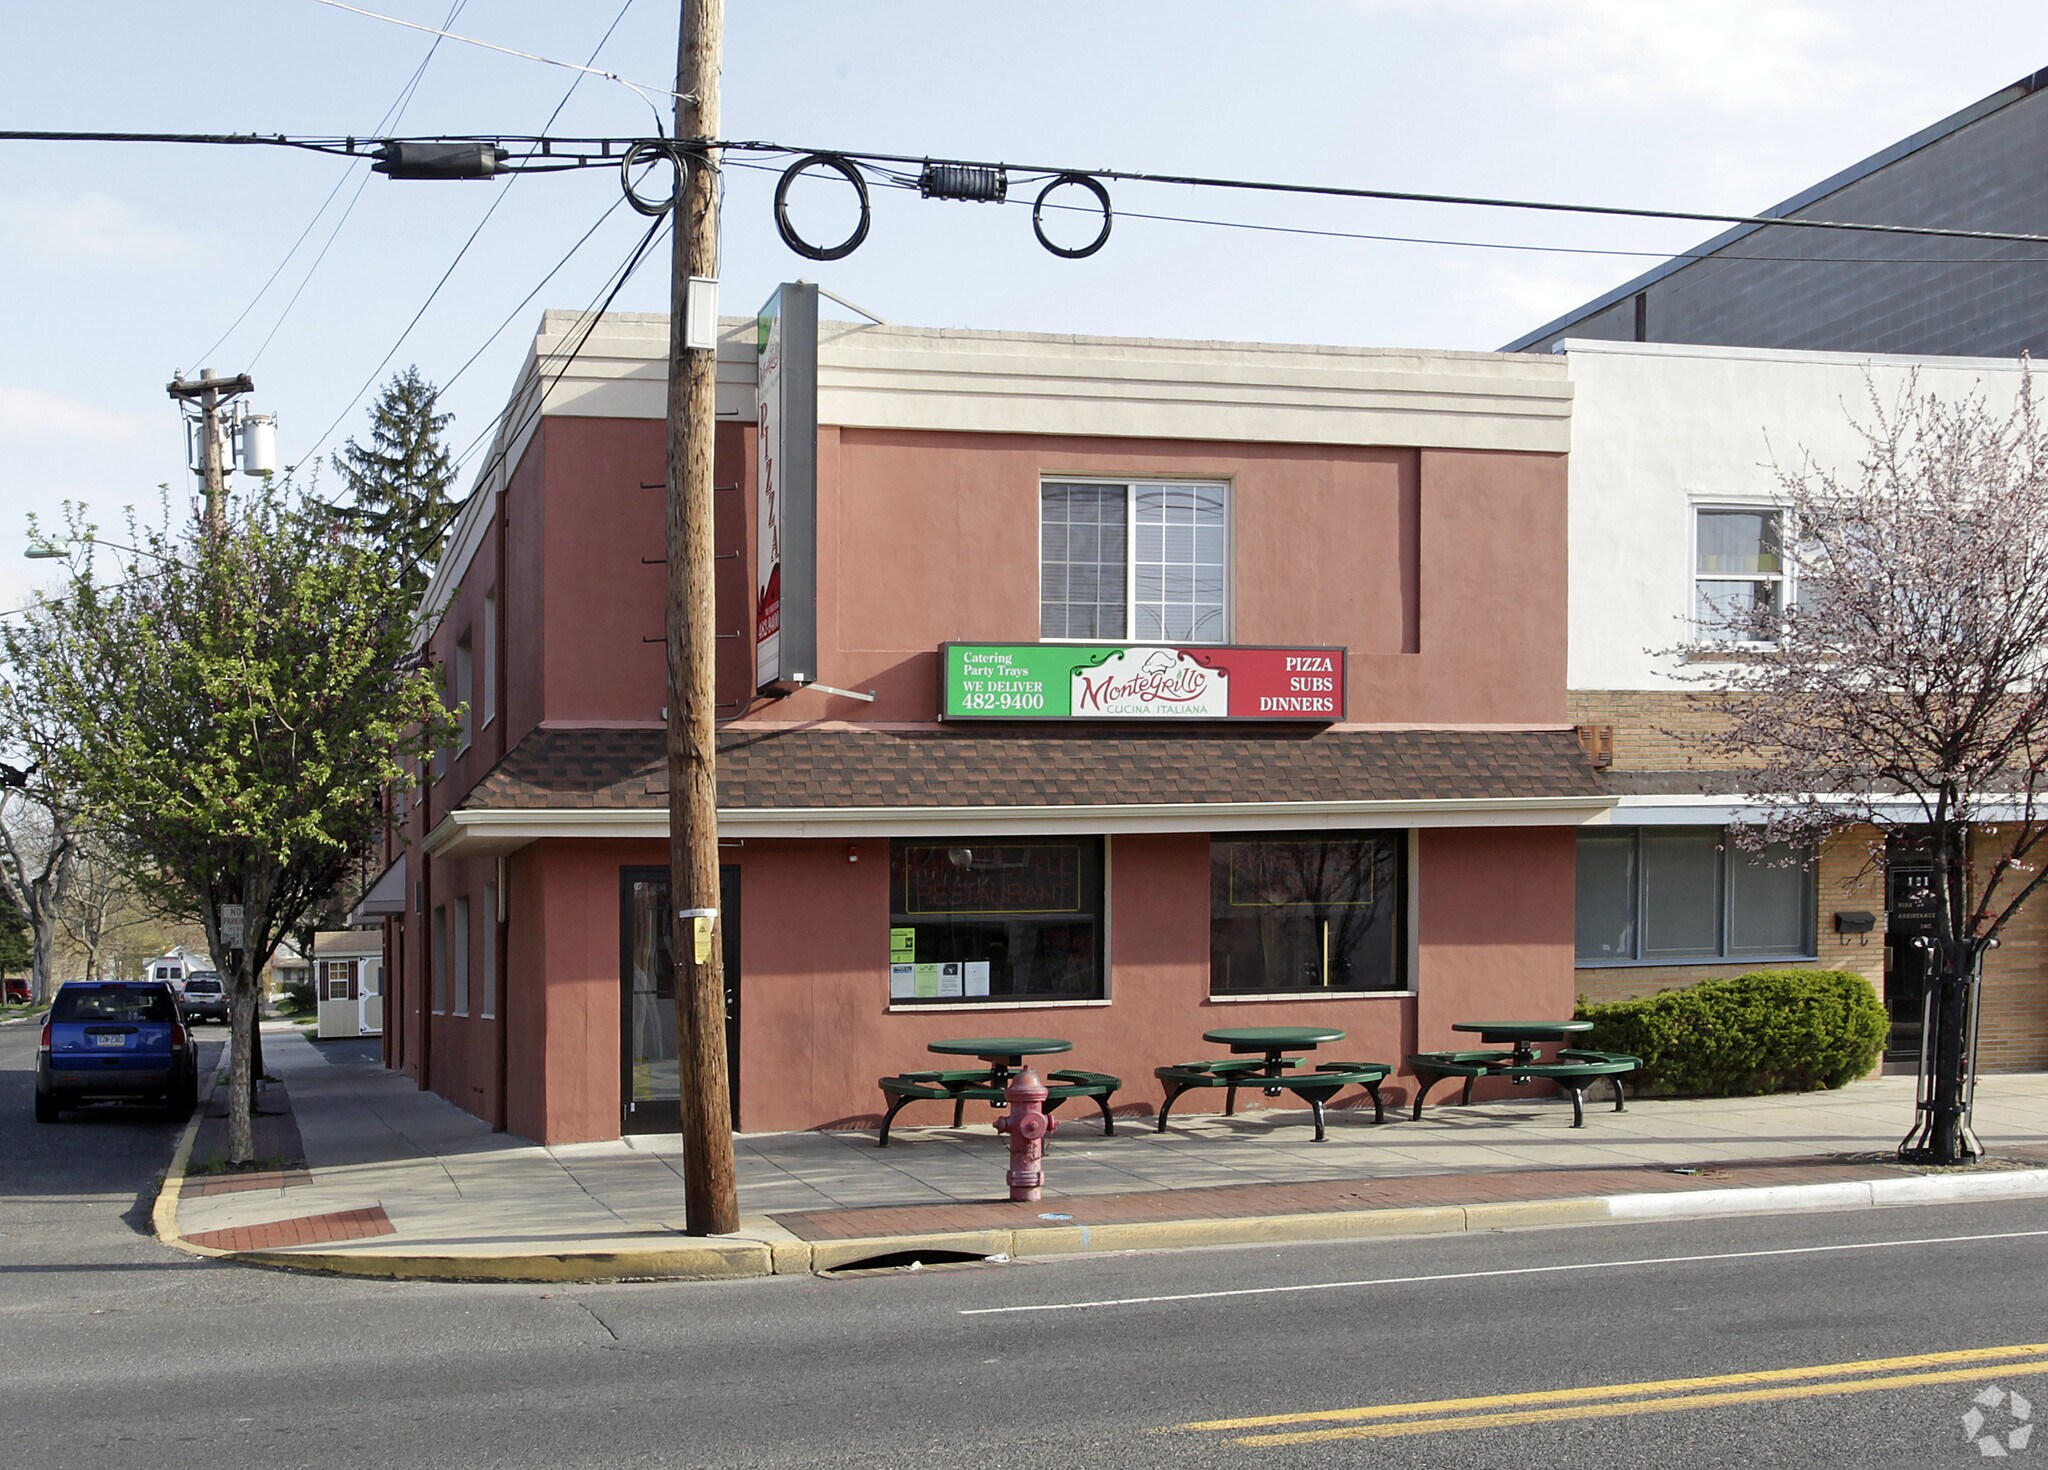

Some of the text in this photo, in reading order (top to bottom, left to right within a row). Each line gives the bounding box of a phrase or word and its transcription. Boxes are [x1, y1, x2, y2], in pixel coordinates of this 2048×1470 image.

[760, 402, 780, 562] PIZZA
[963, 652, 1013, 664] Catering
[1286, 657, 1333, 672] PIZZA
[963, 664, 1029, 678] Party Trays
[963, 681, 1043, 693] WE DELIVER
[1290, 677, 1333, 692] SUBS
[962, 693, 1044, 710] 482-9400
[1107, 704, 1208, 714] CUCINA ITALIANA
[1260, 697, 1333, 712] DINNERS
[917, 883, 1071, 906] RESTAURANT
[230, 908, 241, 917] NO
